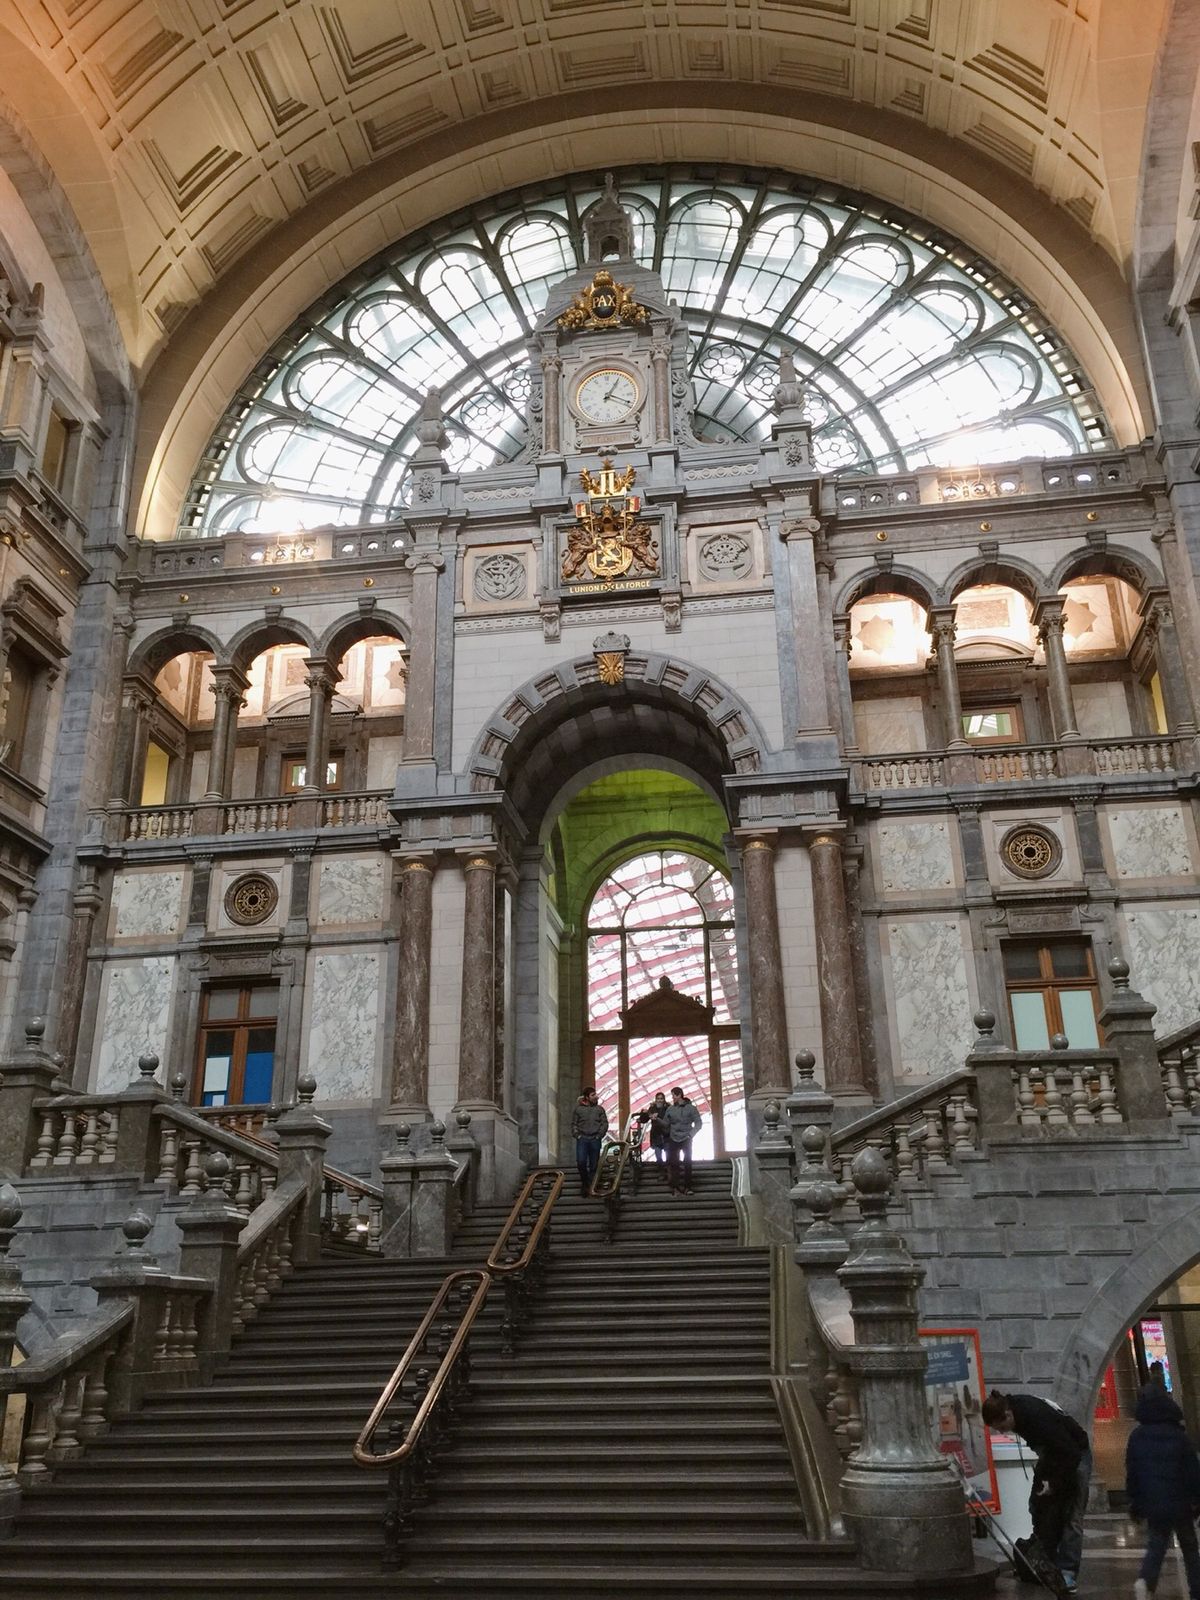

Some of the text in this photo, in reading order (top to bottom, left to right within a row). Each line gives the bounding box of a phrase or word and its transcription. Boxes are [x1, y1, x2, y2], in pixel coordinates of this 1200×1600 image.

[592, 294, 617, 309] PAX
[615, 582, 624, 590] LA
[626, 580, 651, 590] FORCE
